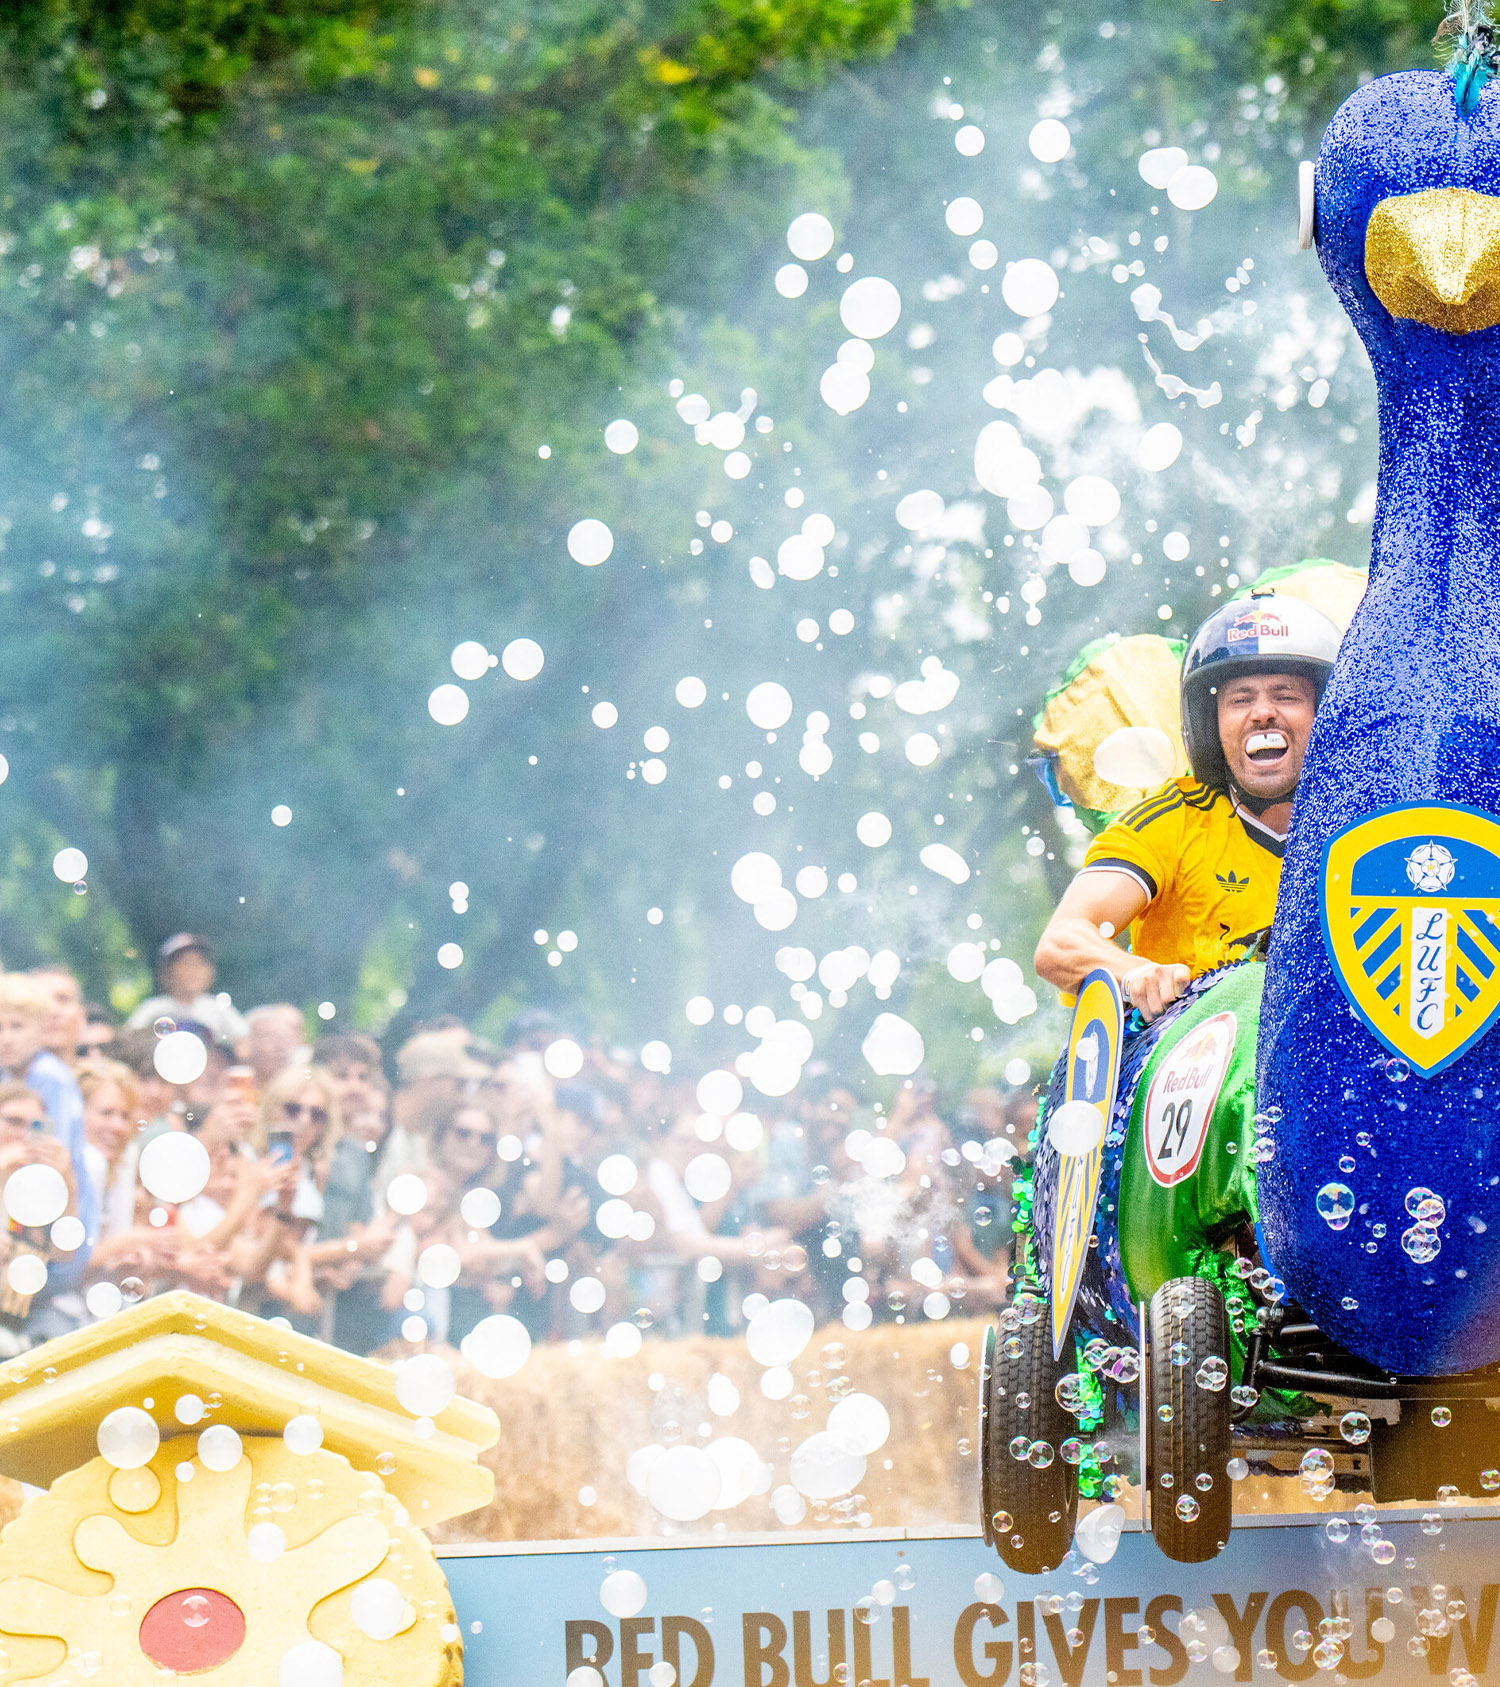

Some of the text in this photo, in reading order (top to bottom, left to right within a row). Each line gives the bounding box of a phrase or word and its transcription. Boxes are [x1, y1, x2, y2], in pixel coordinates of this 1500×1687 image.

[1228, 624, 1289, 641] Red Bull
[1415, 912, 1443, 1030] LUFC
[1164, 1065, 1211, 1093] Red Bull
[1157, 1099, 1193, 1160] 29
[742, 1606, 930, 1687] BULL
[953, 1593, 1191, 1687] GIVES
[1211, 1588, 1386, 1683] YOU
